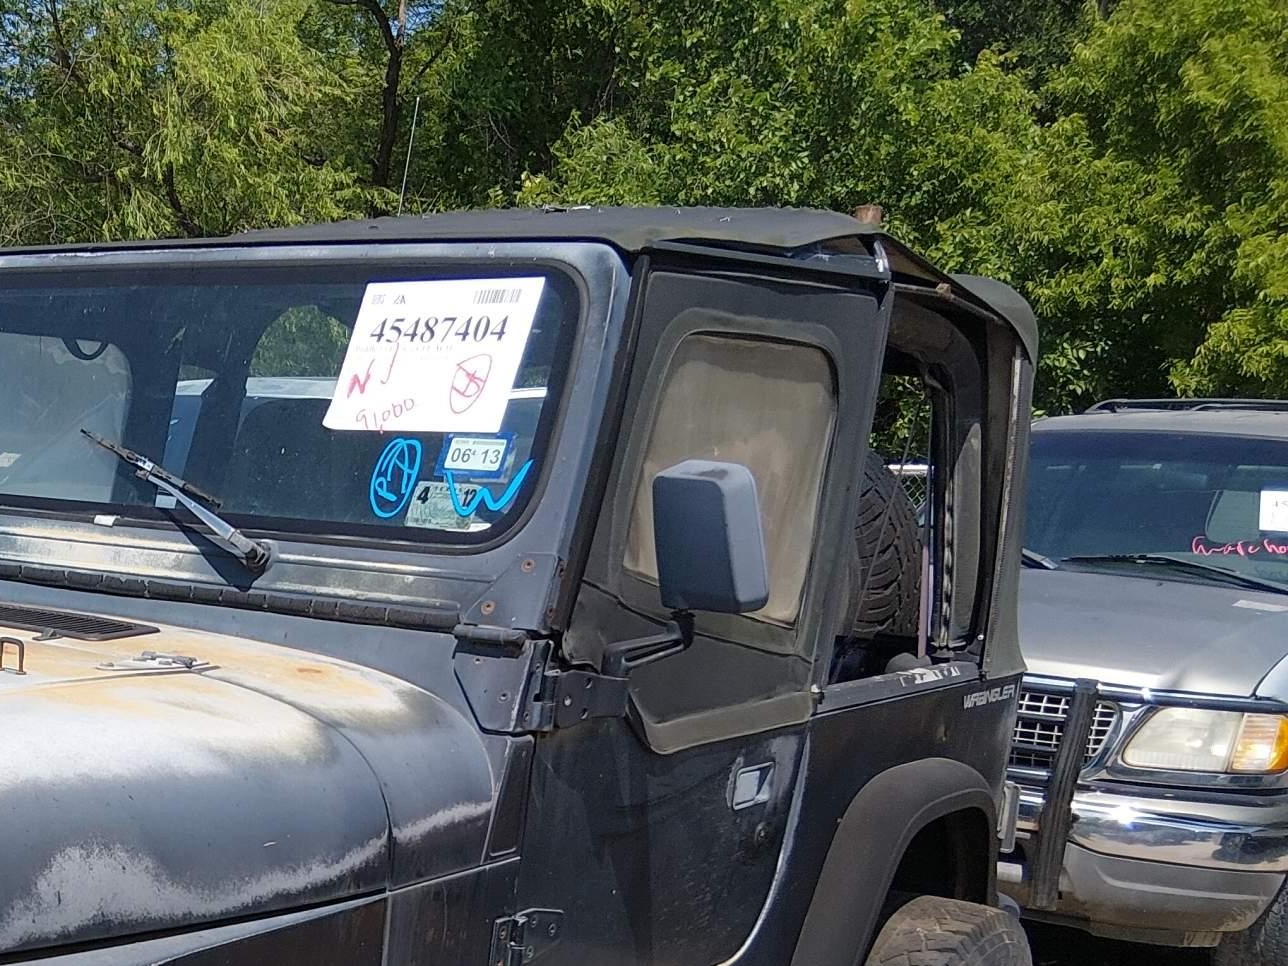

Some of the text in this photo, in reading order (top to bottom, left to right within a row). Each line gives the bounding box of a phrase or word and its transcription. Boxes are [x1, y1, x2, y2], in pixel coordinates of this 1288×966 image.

[370, 315, 510, 344] 45487404
[451, 447, 501, 465] 06 13
[416, 485, 431, 505] 4
[963, 684, 1016, 710] WRANGLER
